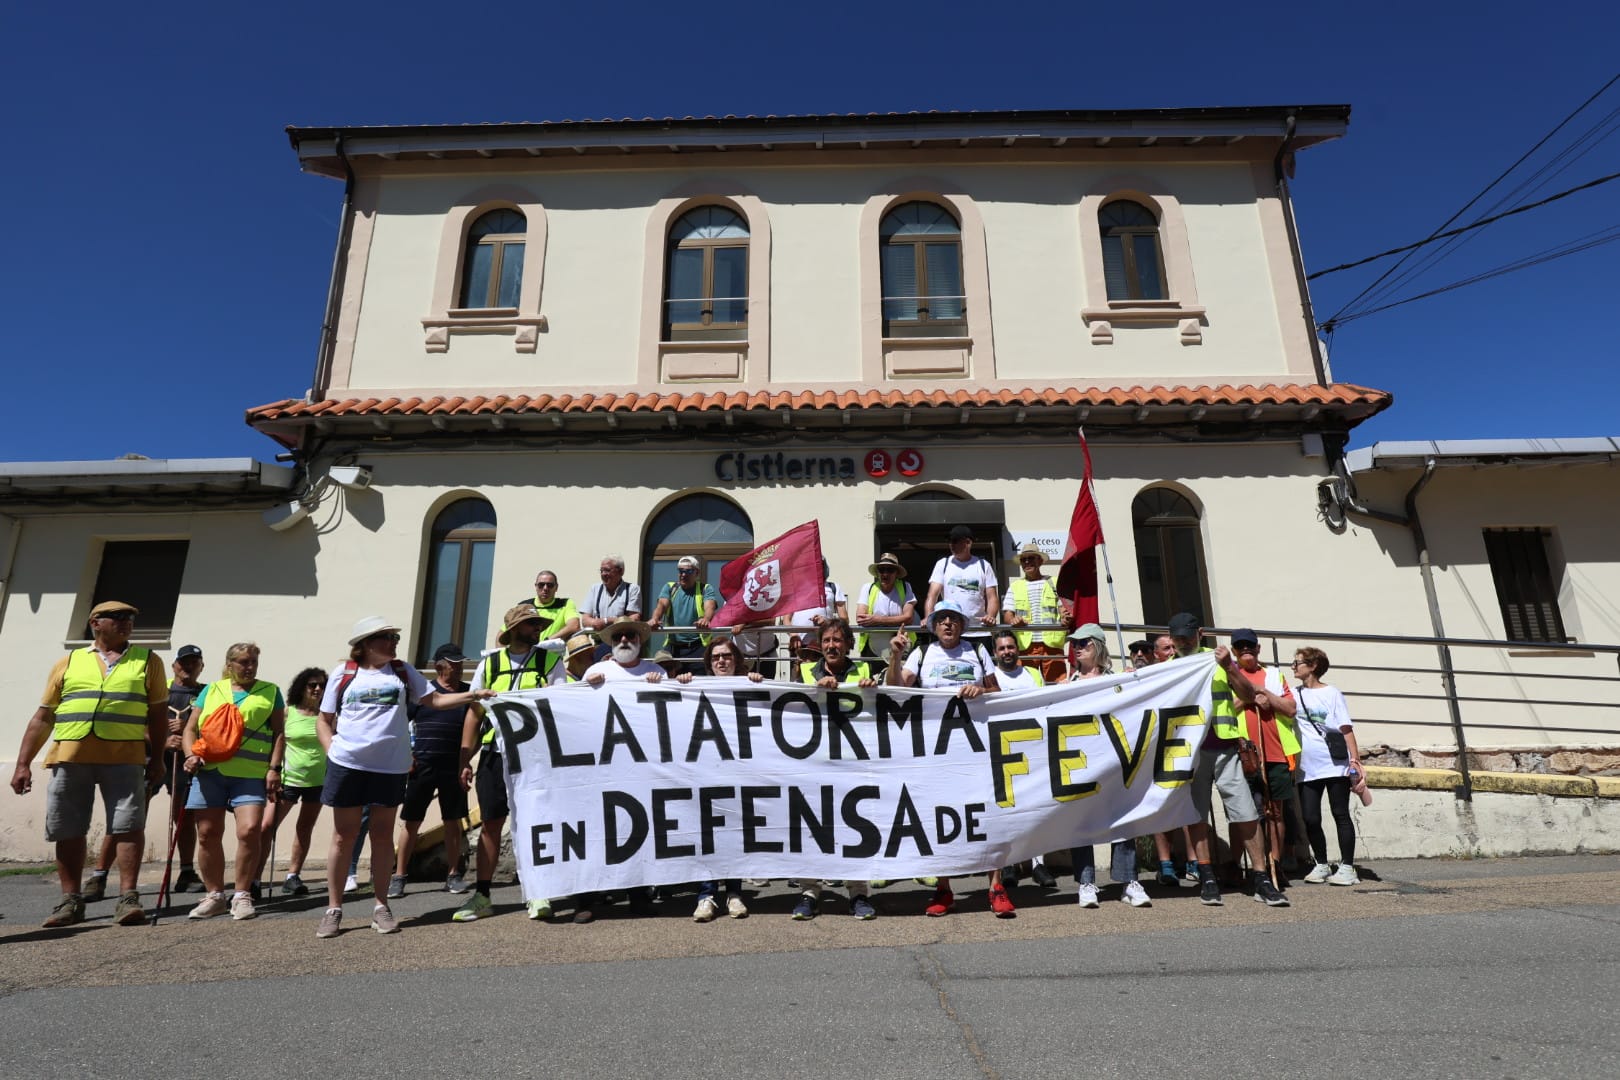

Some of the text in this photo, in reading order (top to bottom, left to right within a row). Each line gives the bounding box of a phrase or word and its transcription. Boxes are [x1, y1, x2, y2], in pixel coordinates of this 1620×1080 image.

[714, 452, 856, 481] Cistierna
[1031, 537, 1060, 546] Acceso
[490, 690, 986, 775] PLATAFORMA
[531, 705, 1206, 866] EN DEFENSA DE FEVE
